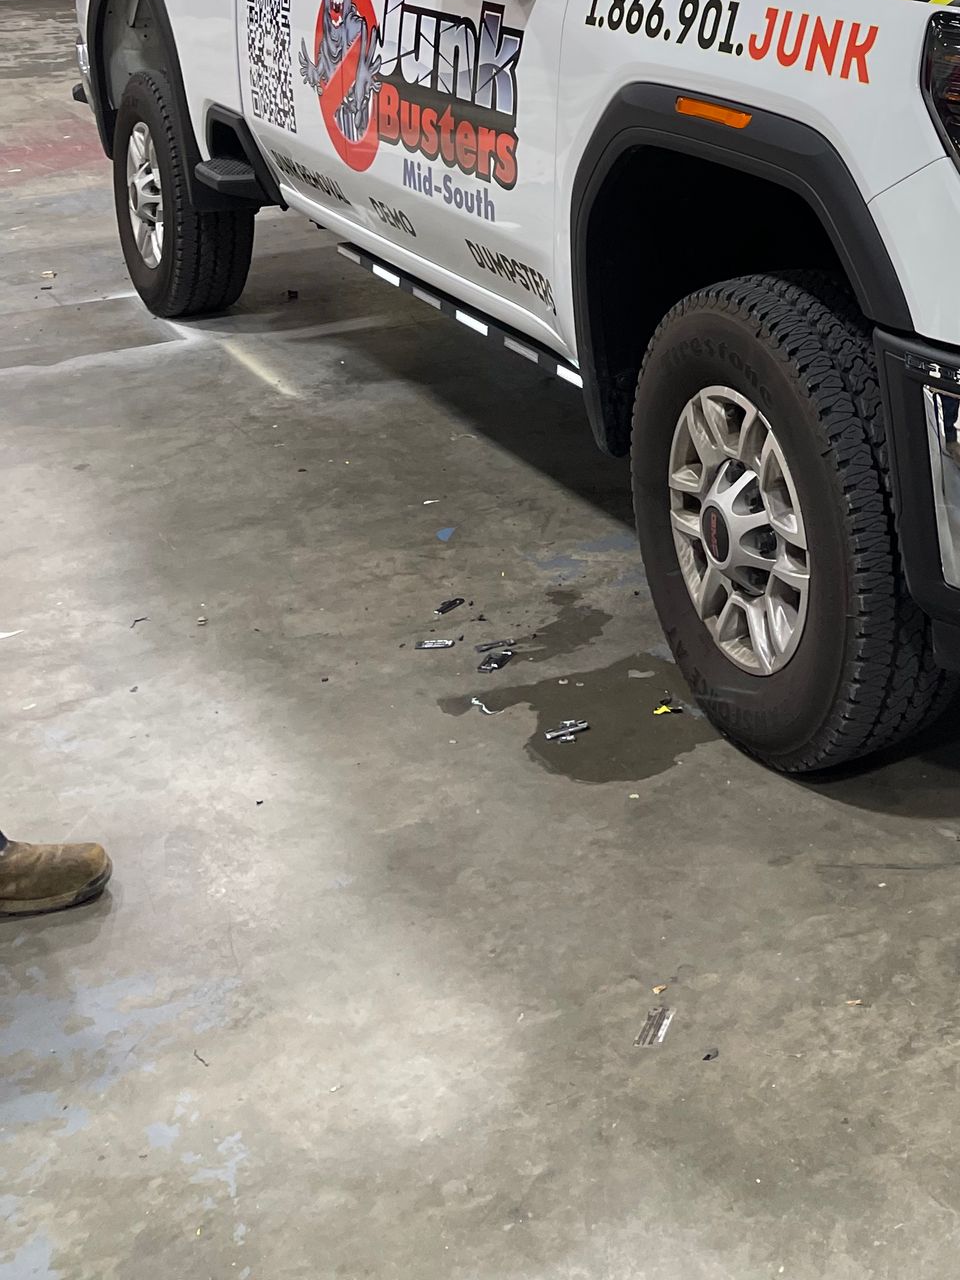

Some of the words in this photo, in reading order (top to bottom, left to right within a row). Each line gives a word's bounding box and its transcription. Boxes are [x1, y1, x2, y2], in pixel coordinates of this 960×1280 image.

[377, 80, 519, 191] Busters
[368, 196, 417, 237] DEMO
[402, 158, 496, 222] Mid-South
